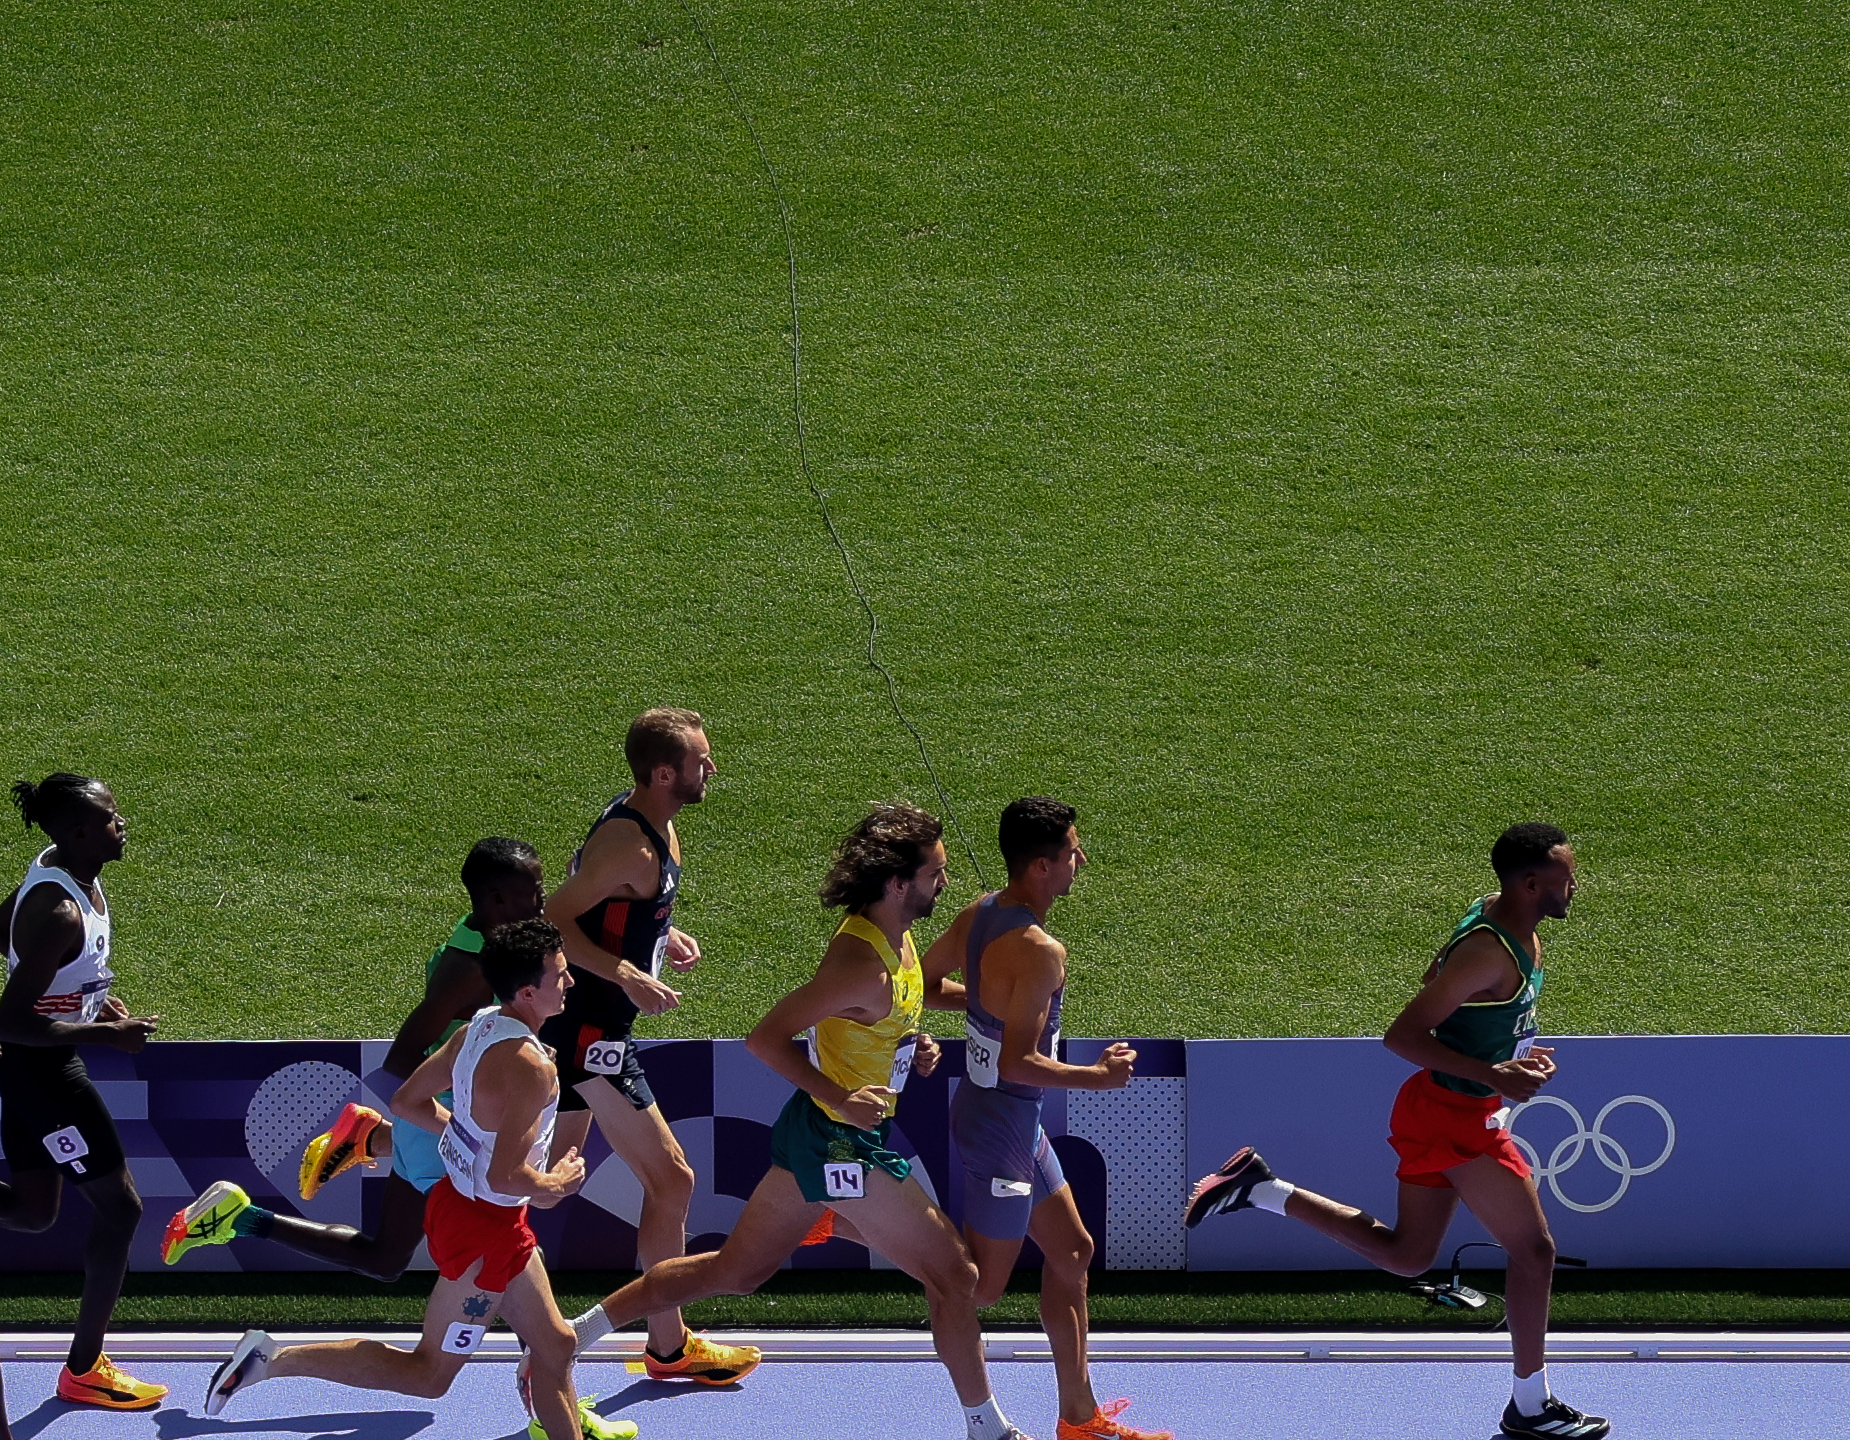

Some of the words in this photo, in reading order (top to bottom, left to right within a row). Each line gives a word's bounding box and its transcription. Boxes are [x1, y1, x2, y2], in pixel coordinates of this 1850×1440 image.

[587, 1047, 622, 1067] 20
[57, 1135, 77, 1154] 8
[830, 1169, 859, 1190] 14
[454, 1329, 473, 1349] 5
